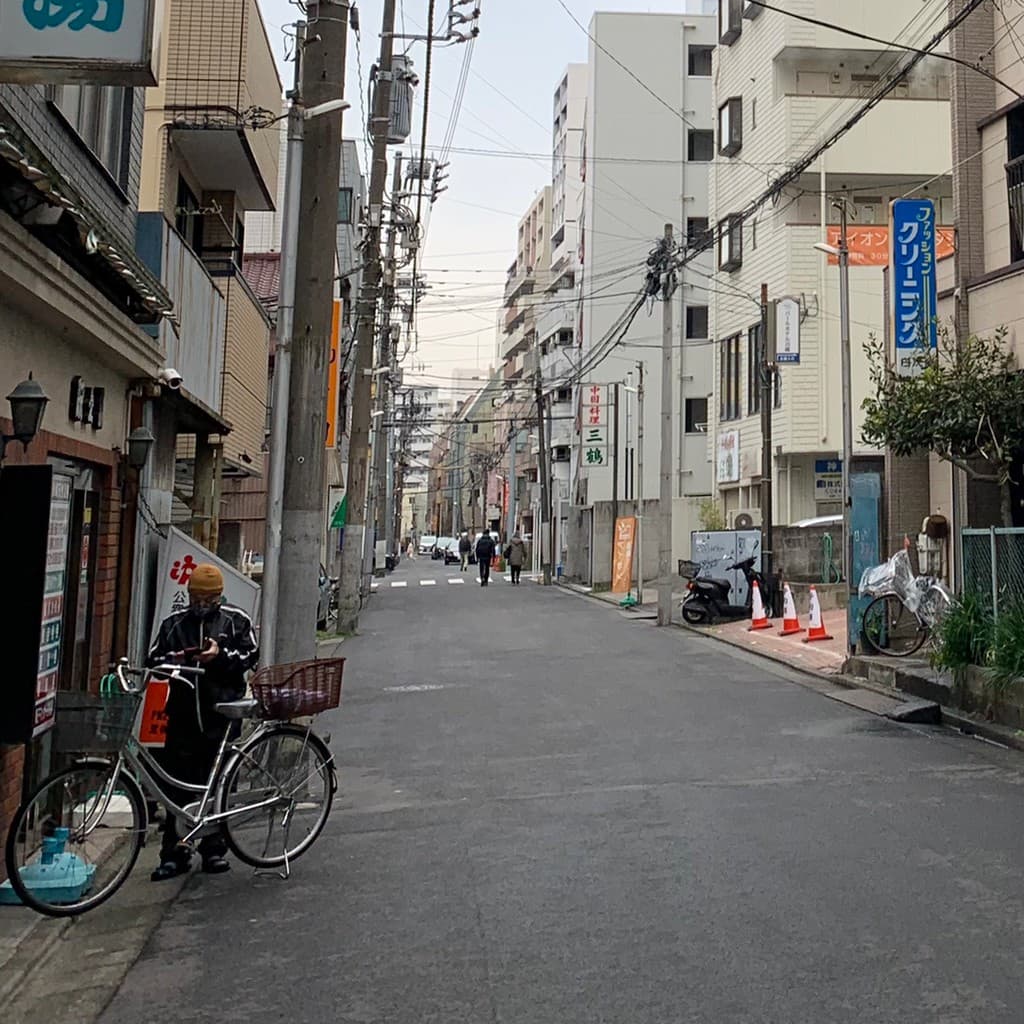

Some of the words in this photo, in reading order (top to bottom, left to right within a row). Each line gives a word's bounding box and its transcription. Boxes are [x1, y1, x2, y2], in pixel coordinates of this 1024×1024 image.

[898, 222, 920, 344] クリーニング
[916, 207, 932, 275] ファッション
